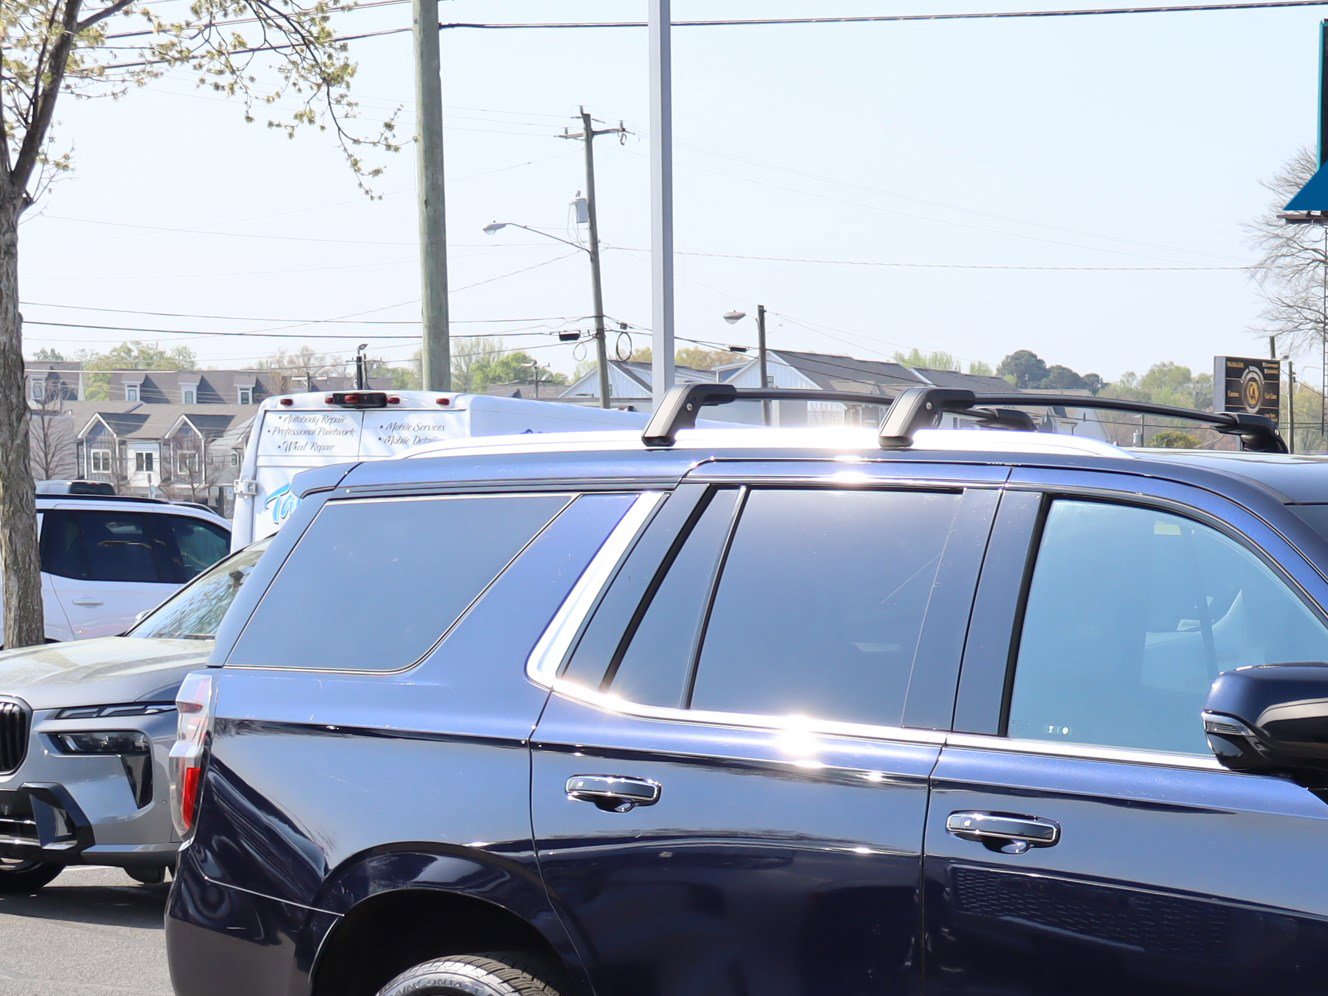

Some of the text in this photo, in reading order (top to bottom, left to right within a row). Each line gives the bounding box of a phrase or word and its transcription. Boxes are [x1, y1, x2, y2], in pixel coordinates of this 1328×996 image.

[321, 415, 347, 425] Repair
[272, 427, 316, 437] Professional
[386, 422, 446, 432] Mobile Services
[384, 435, 410, 445] Mobile
[283, 441, 335, 453] Wheel Repair
